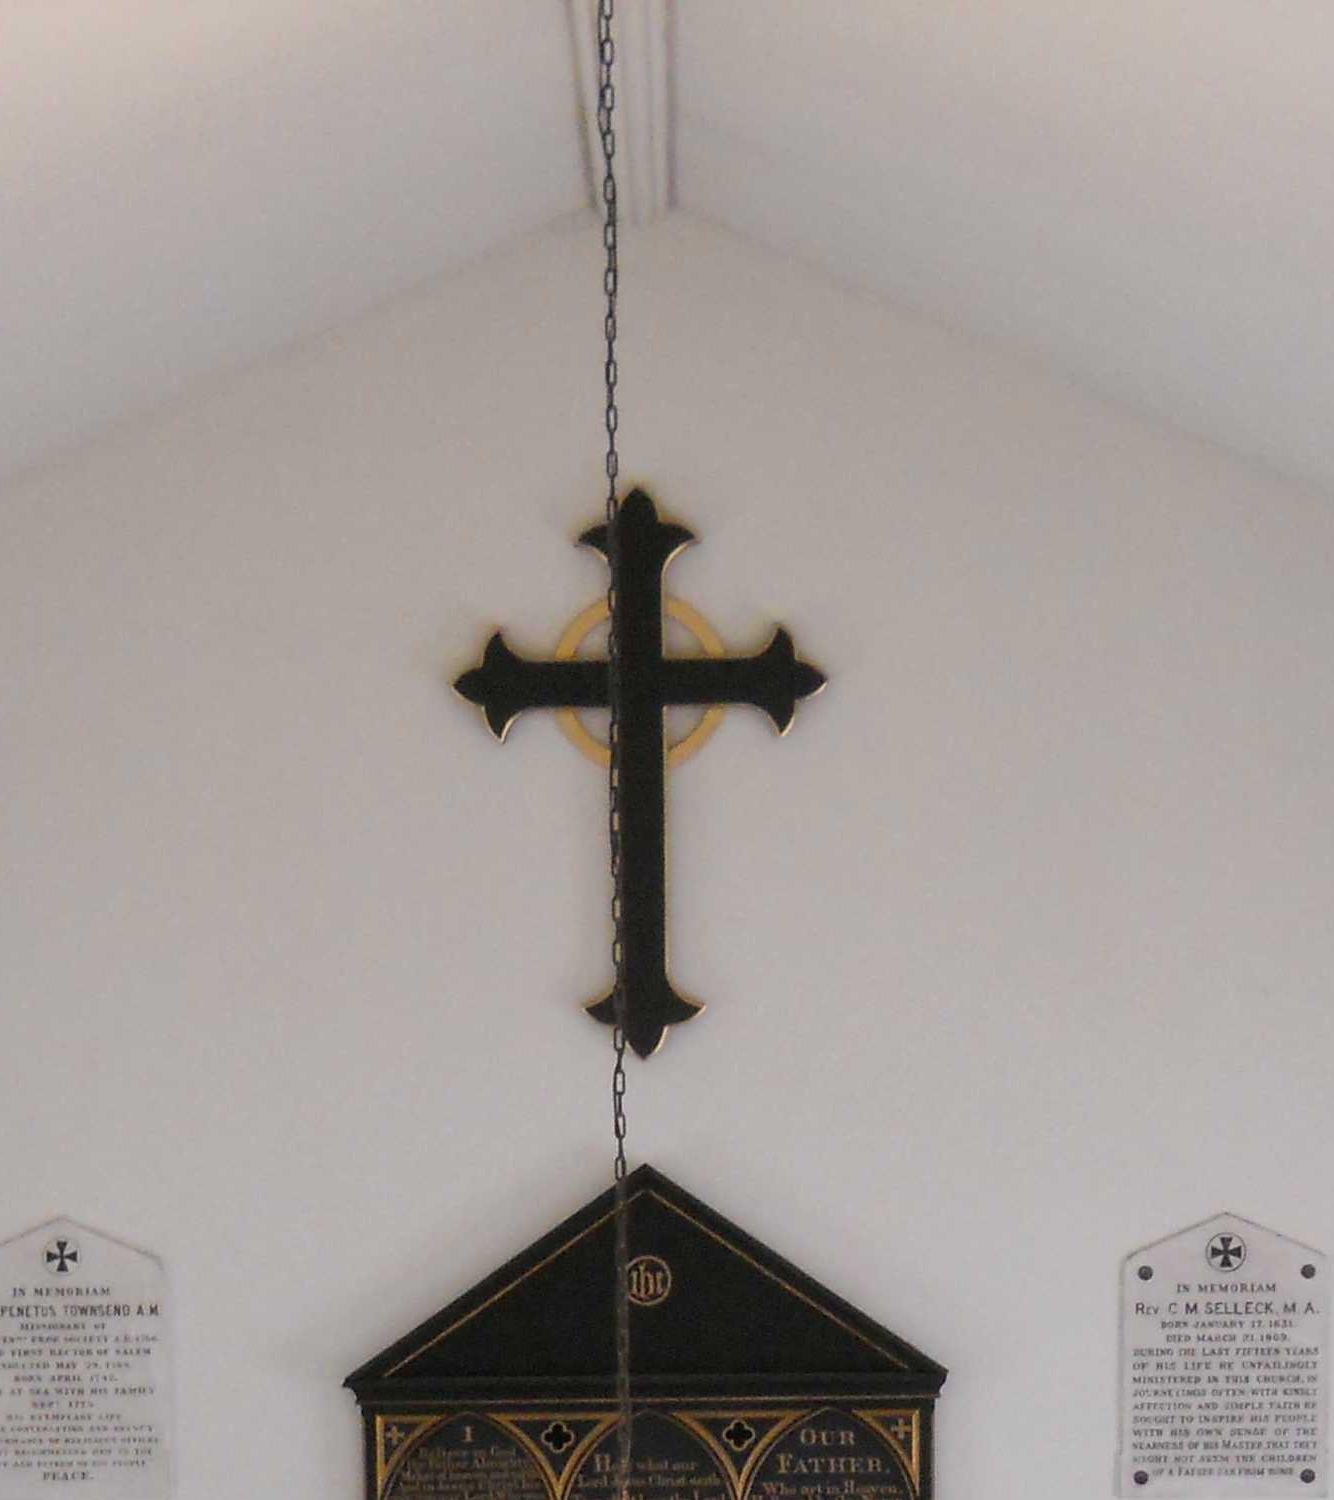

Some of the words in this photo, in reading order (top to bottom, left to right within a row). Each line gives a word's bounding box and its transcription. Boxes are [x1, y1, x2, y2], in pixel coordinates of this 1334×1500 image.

[34, 1287, 111, 1297] MEMORIAM
[1177, 1283, 1190, 1293] IN
[1198, 1283, 1277, 1293] MEMORIAM
[63, 1304, 131, 1318] TOWNSEND
[1161, 1320, 1188, 1329] BORN
[1193, 1320, 1245, 1329] JANUARY
[1166, 1333, 1191, 1342] DIED
[1197, 1333, 1236, 1342] MARCH
[11, 1348, 43, 1357] FIRST
[49, 1348, 93, 1357] RECTOR
[96, 1348, 108, 1357] OF
[115, 1348, 152, 1357] SALEM
[1133, 1347, 1174, 1357] DURING
[1202, 1347, 1230, 1357] LAST
[1235, 1347, 1280, 1356] FIFTEEN
[1285, 1346, 1319, 1356] YEARS
[56, 1361, 77, 1370] MAY
[1132, 1361, 1148, 1371] OF
[1156, 1361, 1176, 1371] HIS
[1184, 1361, 1211, 1371] LIFE
[1219, 1361, 1234, 1371] HE
[1242, 1361, 1318, 1371] UNFAILINGLY
[1132, 1375, 1201, 1384] MINISTERED
[1207, 1375, 1219, 1384] IN
[1225, 1375, 1250, 1384] THIS
[1251, 1388, 1278, 1397] WITH
[1132, 1402, 1192, 1411] AFFECTION
[1197, 1402, 1218, 1411] AND
[1225, 1402, 1264, 1411] SIMPLE
[1269, 1402, 1300, 1411] FAITH
[1133, 1415, 1175, 1424] SOUGHT
[1180, 1415, 1194, 1424] TO
[1198, 1415, 1244, 1424] INSPIRE
[1250, 1415, 1270, 1424] HIS
[1274, 1415, 1318, 1424] PEOPLE
[800, 1428, 855, 1445] OUR
[1133, 1428, 1164, 1437] WITH
[1170, 1428, 1190, 1437] HIS
[1196, 1428, 1223, 1437] OWN
[1230, 1428, 1266, 1437] SENSE
[1274, 1428, 1289, 1437] OF
[1296, 1428, 1318, 1437] THE
[1132, 1441, 1184, 1450] NEARNESS
[1188, 1441, 1200, 1450] OF
[1174, 1455, 1195, 1463] NOT
[1199, 1455, 1230, 1463] SEEM
[1236, 1455, 1256, 1463] THE
[1261, 1455, 1318, 1463] CHILDREN
